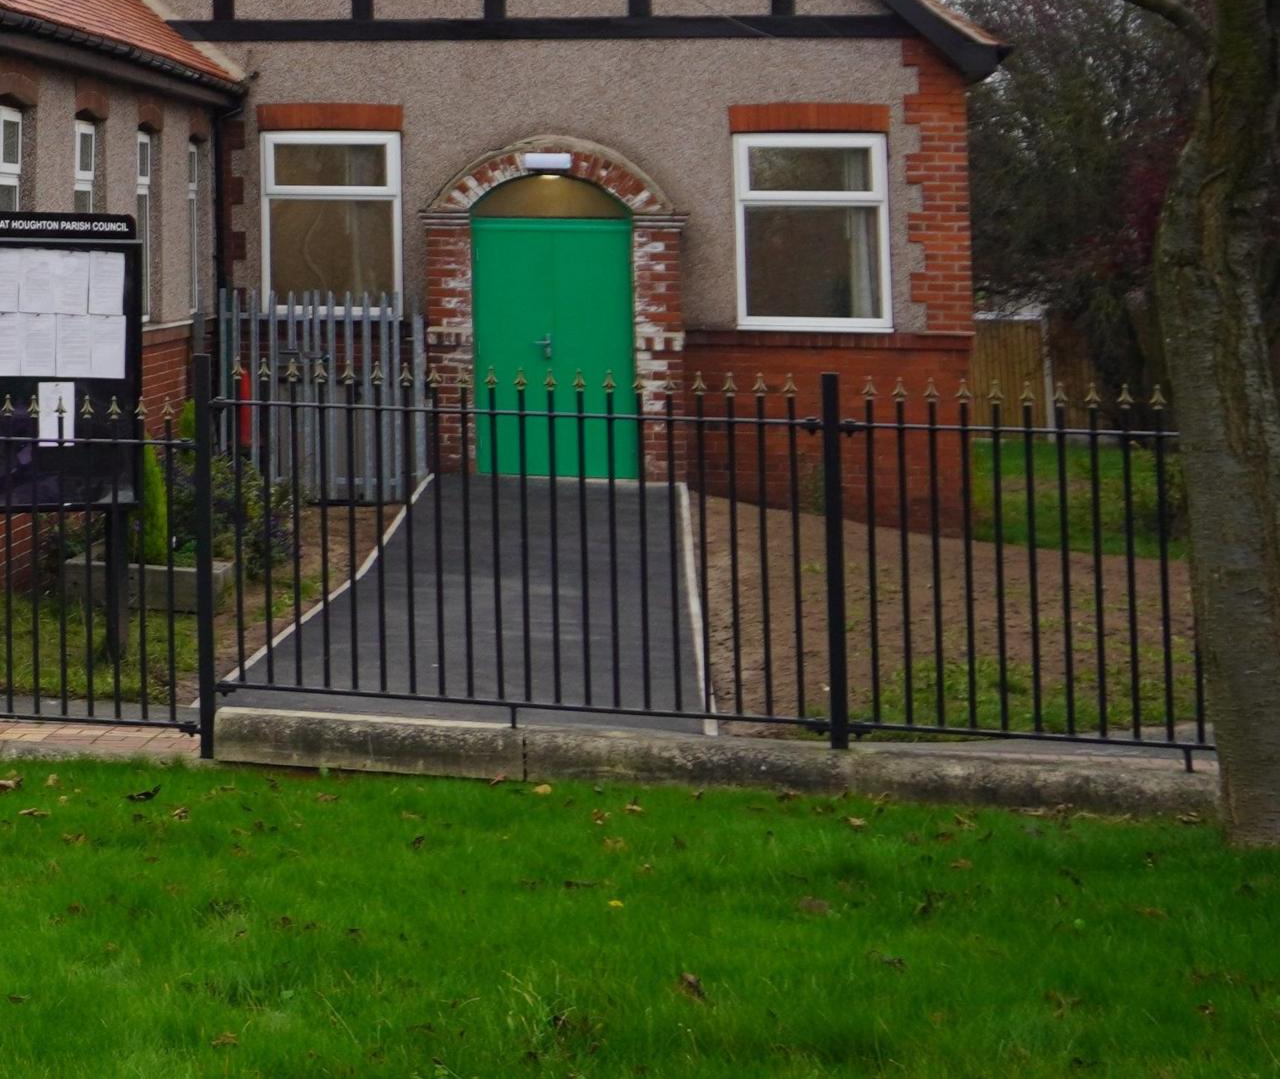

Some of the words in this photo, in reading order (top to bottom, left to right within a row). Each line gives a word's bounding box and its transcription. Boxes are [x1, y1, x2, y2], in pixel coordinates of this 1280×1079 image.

[11, 219, 59, 230] HOUGHTON
[60, 221, 91, 231] PARISH
[92, 221, 129, 232] COUNCIL
